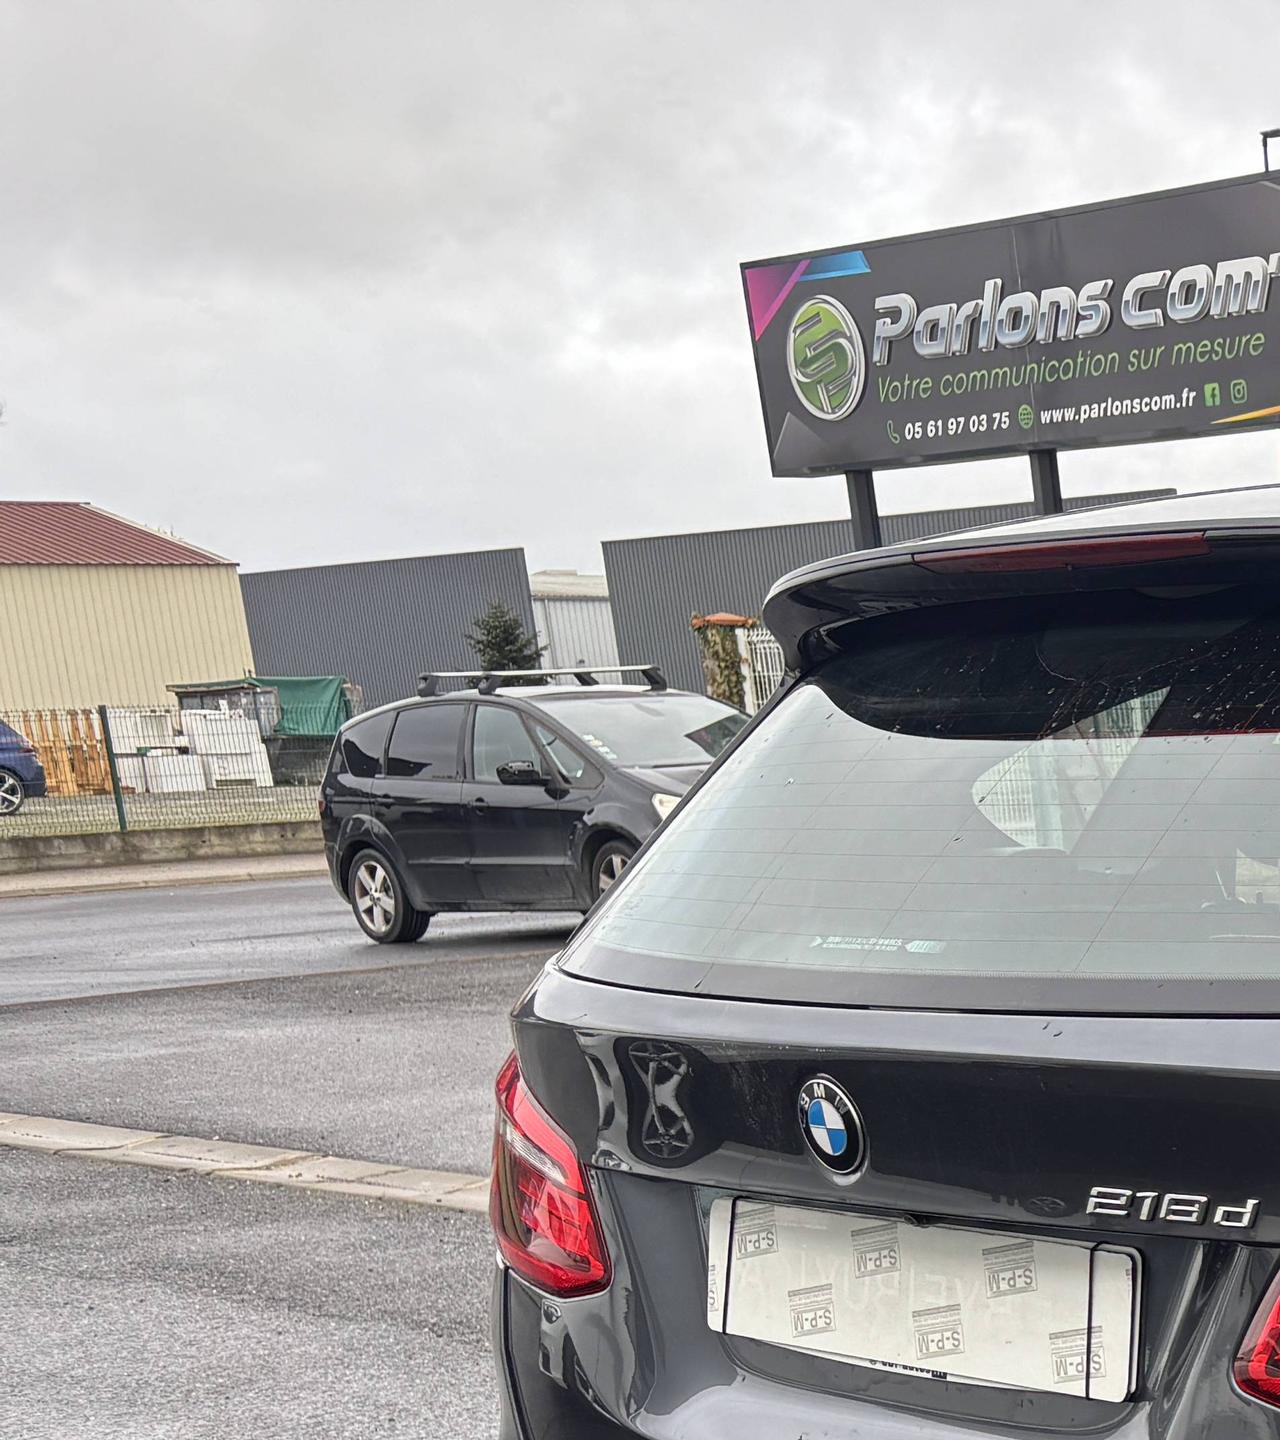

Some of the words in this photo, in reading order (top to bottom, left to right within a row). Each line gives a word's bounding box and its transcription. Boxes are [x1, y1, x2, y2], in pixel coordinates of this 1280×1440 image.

[872, 278, 1113, 367] Parlons
[878, 373, 932, 403] Votre
[940, 349, 1120, 397] communication
[1127, 344, 1166, 373] sur
[1171, 332, 1265, 366] mesure
[904, 421, 923, 440] 05
[926, 419, 943, 438] 61
[947, 416, 965, 435] 97
[969, 413, 987, 433] 03
[992, 411, 1010, 430] 75
[1040, 387, 1197, 424] www.parlonscom.fr
[736, 1230, 775, 1253] S-P-M
[856, 1249, 898, 1272] S-P-M
[988, 1268, 1034, 1292] S-P-M
[793, 1308, 833, 1332] S-P-M
[917, 1330, 962, 1354] S-P-M
[1055, 1352, 1103, 1378] SP-M
